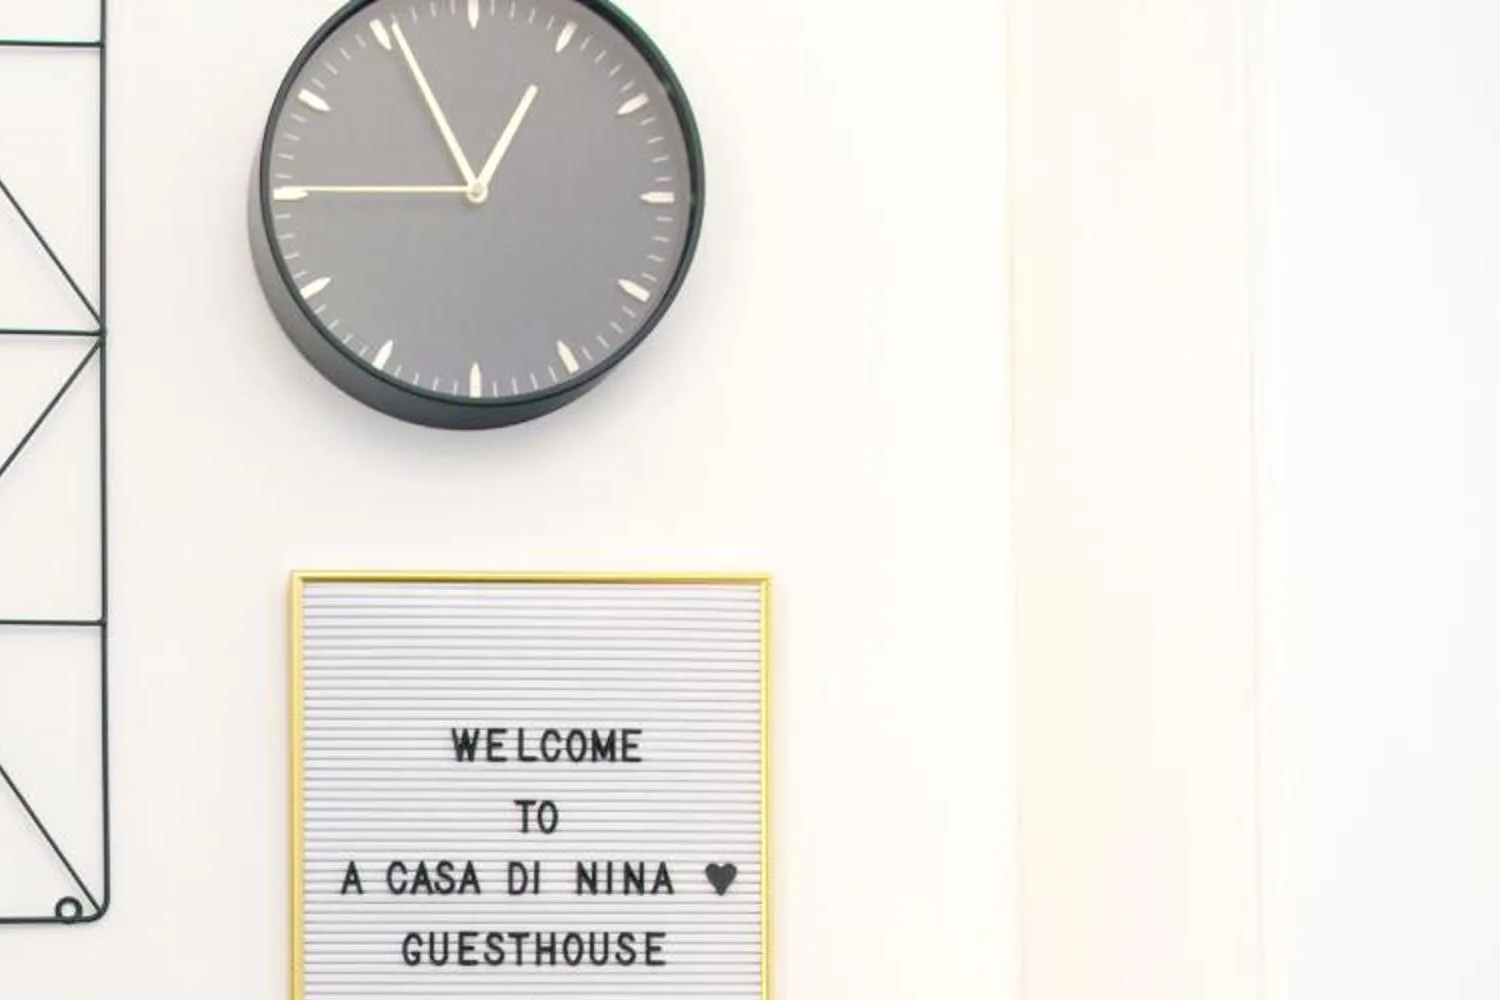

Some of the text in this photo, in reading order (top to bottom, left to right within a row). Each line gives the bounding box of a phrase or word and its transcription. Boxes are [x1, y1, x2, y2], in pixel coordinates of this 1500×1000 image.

[451, 727, 643, 763] WELCOME
[514, 799, 560, 835] TO
[341, 860, 675, 895] A CASA DI NINA
[402, 931, 667, 967] GUESTHOUSE
